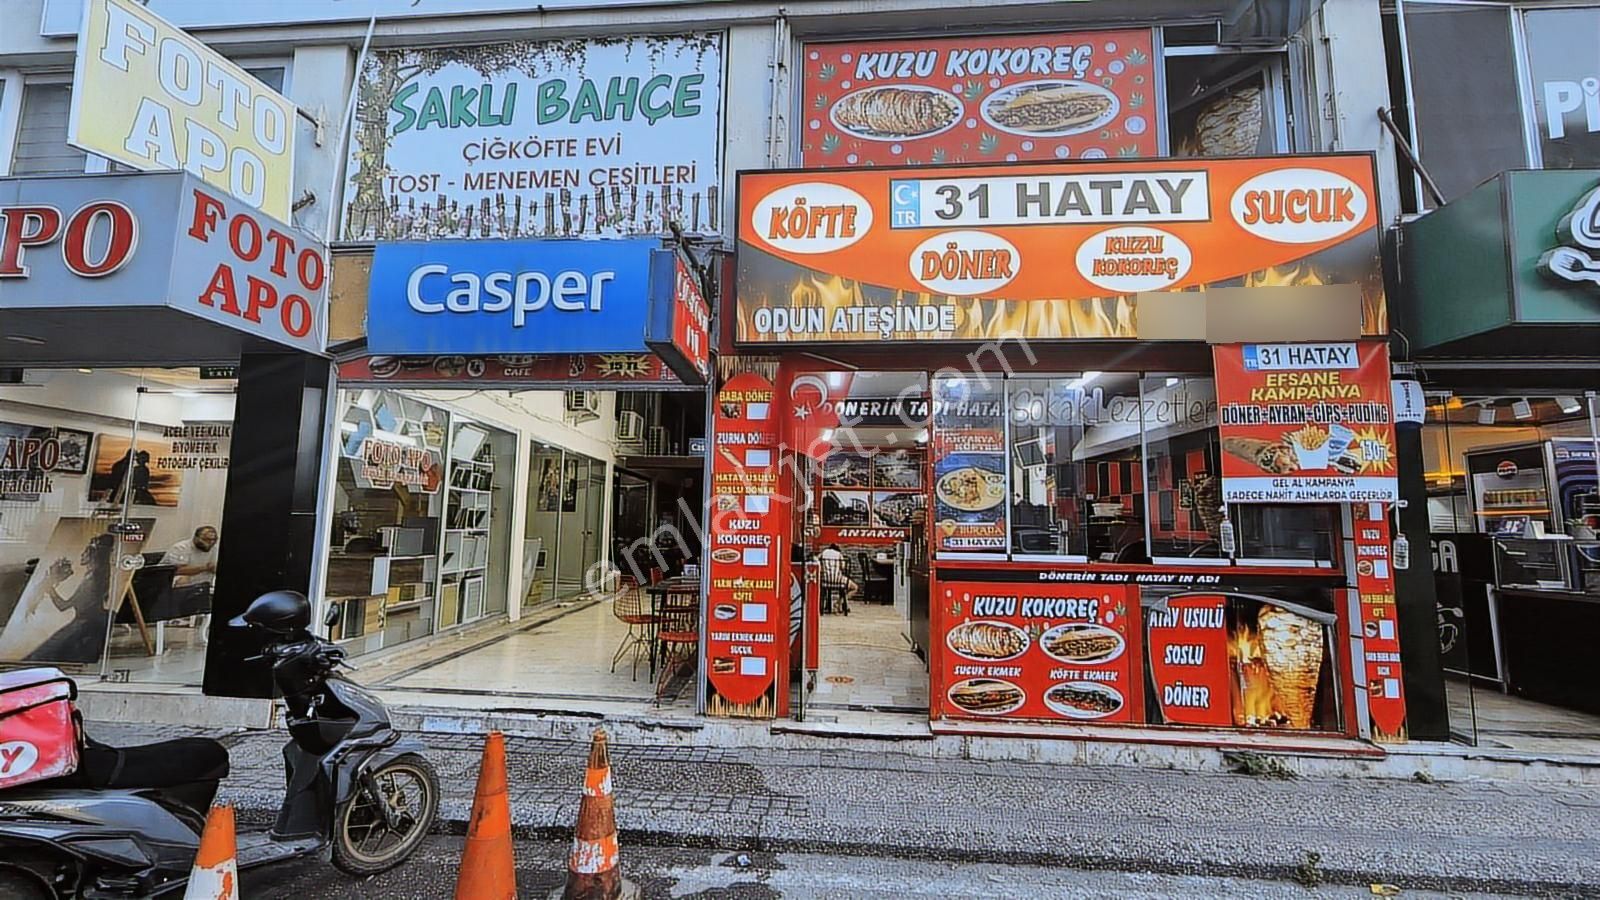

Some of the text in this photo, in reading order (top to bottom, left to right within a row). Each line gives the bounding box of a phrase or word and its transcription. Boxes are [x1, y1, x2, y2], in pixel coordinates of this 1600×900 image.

[854, 44, 1093, 79] KUZU KOKOREÇ
[100, 3, 286, 154] FOTO
[391, 73, 705, 134] SAKLI BAHÇE
[124, 97, 266, 209] APO
[462, 132, 622, 166] ÇİĞKÖFTE EVİ
[388, 174, 441, 193] TOST
[463, 169, 580, 191] MENEMEN
[588, 160, 697, 190] ÇEŞİTLERİ
[934, 177, 1194, 219] 31 HATAY
[1243, 185, 1356, 225] SUCUK
[768, 198, 858, 239] KÖFTE
[894, 210, 917, 225] TR
[188, 189, 324, 291] FOTO
[1104, 235, 1164, 254] KUZU
[921, 243, 1012, 281] DÖNER
[1092, 256, 1178, 280] KOKOREÇ
[198, 263, 313, 338] APO
[406, 264, 616, 328] Casper
[754, 299, 957, 338] ODUN ATEŞİNDE
[1261, 346, 1351, 364] 31 HATAY
[1266, 371, 1340, 387] EFSANE
[719, 391, 743, 402] BABA
[1251, 385, 1361, 401] KAMPANYA
[823, 398, 902, 417] DÖNERİN
[909, 400, 950, 418] TADI
[717, 432, 746, 445] ZURNA
[0, 437, 61, 471] APO
[1226, 490, 1264, 500] SADECE
[1295, 490, 1347, 500] ALIMLARDA
[1272, 479, 1289, 488] GEL
[1291, 479, 1303, 488] AL
[729, 519, 760, 530] KUZU
[837, 528, 905, 538] ANTAKYA
[717, 534, 771, 547] KOKOREÇ
[1039, 570, 1096, 581] DÖNERİN
[1100, 573, 1129, 582] TADI
[1136, 574, 1175, 583] HATAY
[1197, 575, 1220, 584] ADI
[973, 596, 1099, 623] KUZU KOKOREÇ
[1183, 604, 1224, 628] USULÜ
[1164, 645, 1204, 665] SOSLU
[953, 665, 1021, 677] SUCUK EKMEK
[1049, 668, 1118, 681] KÖFTE EKMEK
[1164, 681, 1209, 707] DÖNER
